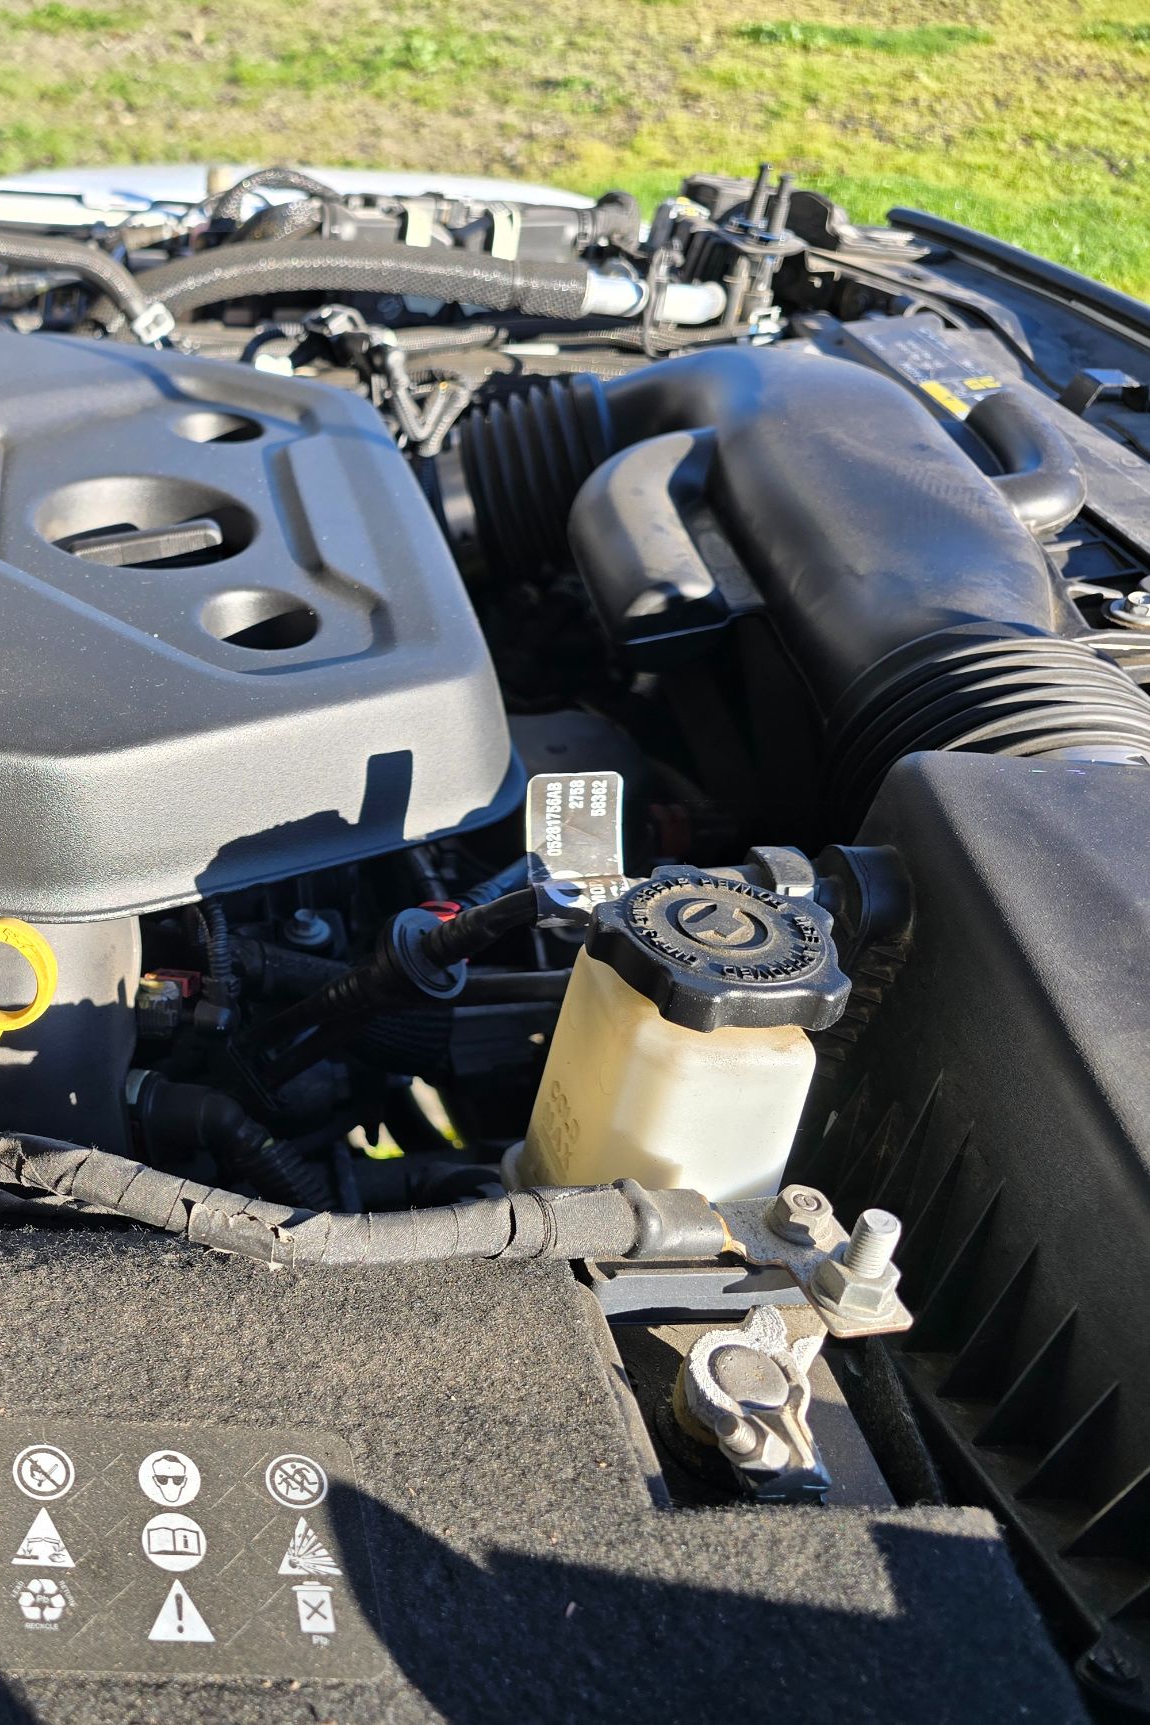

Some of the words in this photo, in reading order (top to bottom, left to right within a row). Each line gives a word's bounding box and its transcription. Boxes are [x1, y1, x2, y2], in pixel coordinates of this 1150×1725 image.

[699, 877, 788, 911] POWER
[793, 914, 821, 945] USE
[722, 943, 821, 982] APPROVED
